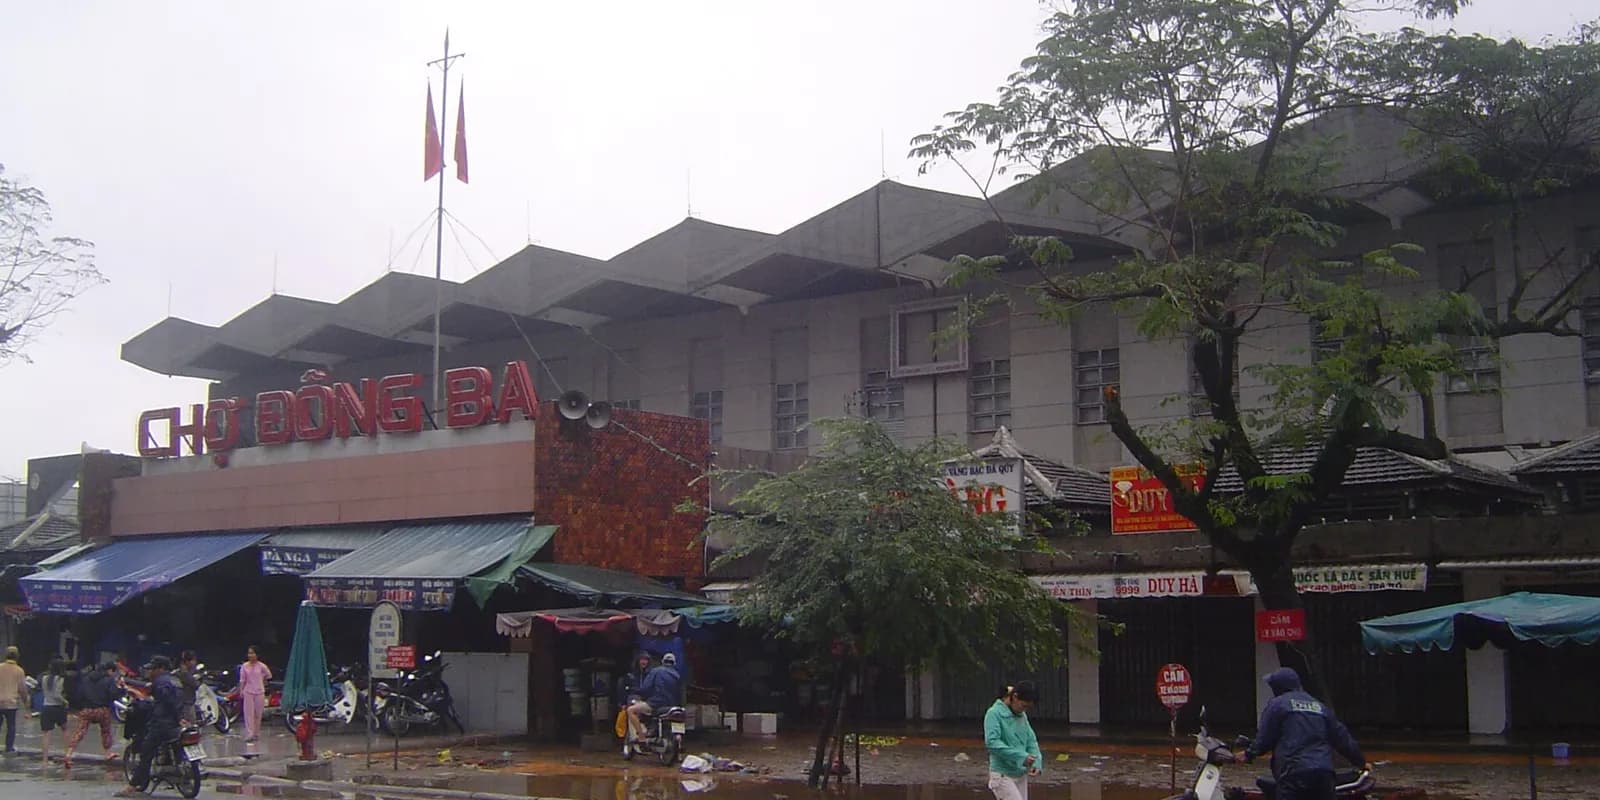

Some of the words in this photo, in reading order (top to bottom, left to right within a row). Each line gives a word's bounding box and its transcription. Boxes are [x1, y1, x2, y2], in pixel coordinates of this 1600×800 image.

[138, 396, 246, 469] CHỢ
[446, 360, 539, 434] BA
[1128, 487, 1168, 513] DUY
[1115, 585, 1140, 595] 9999
[1148, 577, 1175, 593] DUY
[1178, 574, 1199, 593] HÀ
